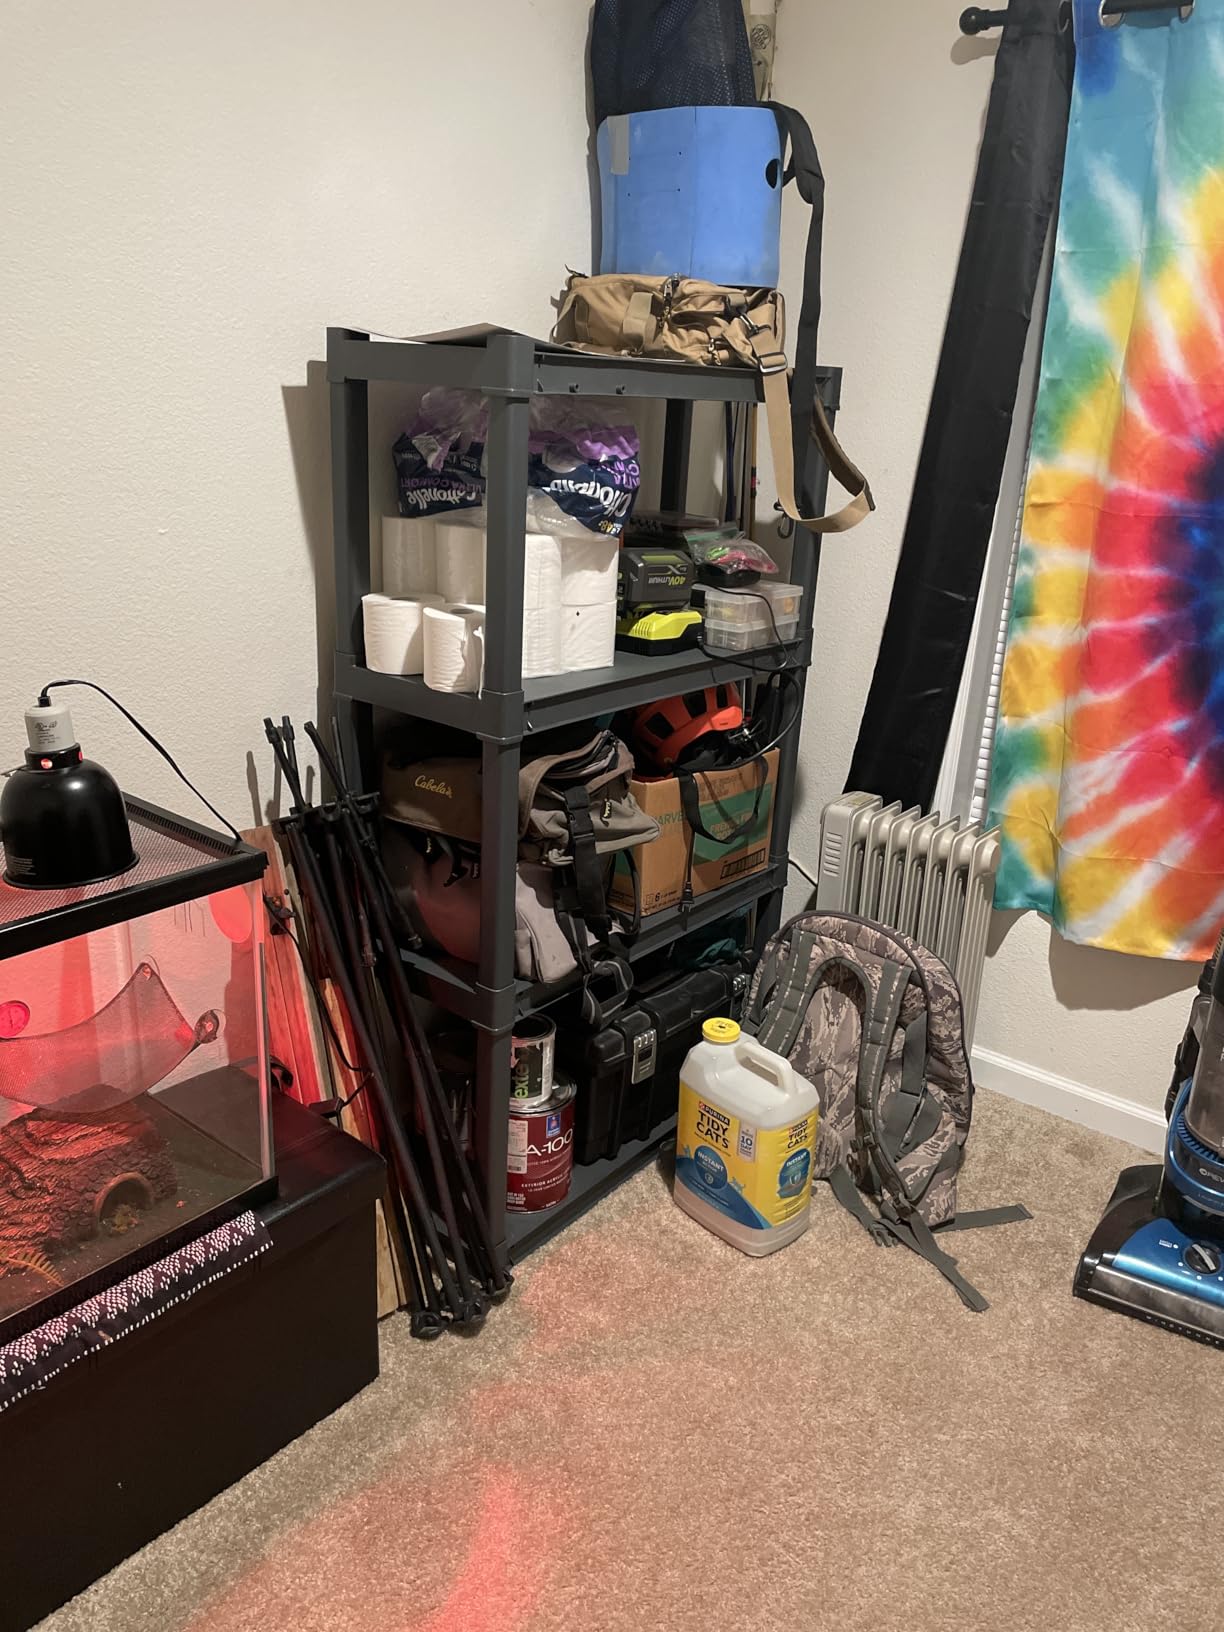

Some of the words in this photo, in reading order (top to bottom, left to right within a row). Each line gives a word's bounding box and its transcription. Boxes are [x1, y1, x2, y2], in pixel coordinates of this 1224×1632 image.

[698, 1110, 728, 1136] TIDY
[705, 1106, 729, 1124] PURINA
[526, 1128, 573, 1157] A-100
[696, 1122, 728, 1149] CATS
[741, 1136, 753, 1146] 10
[787, 1133, 809, 1149] CATS
[788, 1126, 808, 1141] TIDY
